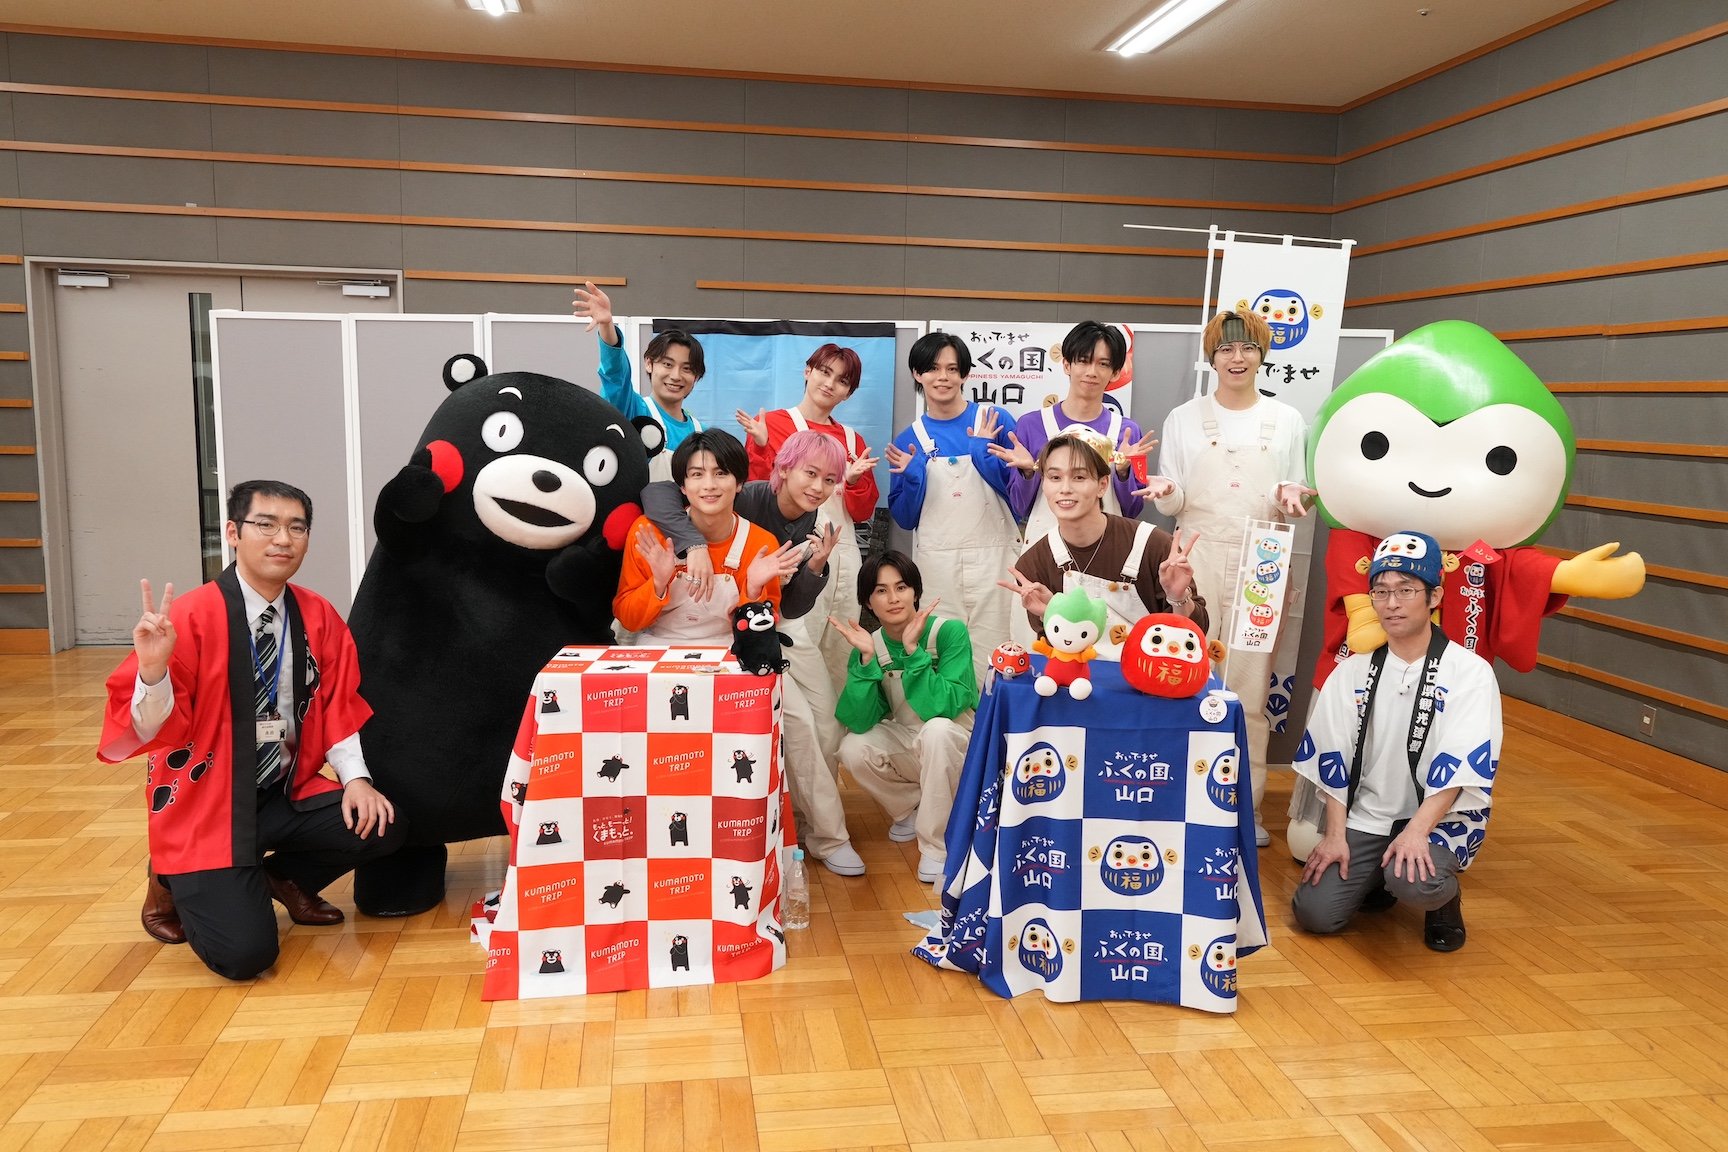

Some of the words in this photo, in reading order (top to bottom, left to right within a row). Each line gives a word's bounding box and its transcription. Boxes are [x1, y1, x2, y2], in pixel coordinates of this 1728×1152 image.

[970, 331, 1030, 345] おいでませ
[970, 346, 1053, 373] くの国、
[1256, 361, 1320, 384] でませ
[971, 381, 1026, 405] 山口
[1156, 661, 1182, 686] 福
[586, 686, 639, 701] KUMAMOTO
[718, 687, 770, 702] KUMAMOTO
[603, 697, 625, 708] TRIP
[734, 699, 756, 709] TRIP
[653, 750, 705, 765] KUMAMOTO
[1115, 751, 1158, 762] おいでませ
[538, 763, 561, 775] TRIP
[669, 762, 691, 772] TRIP
[1098, 760, 1174, 781] ふくの国、
[1028, 779, 1047, 797] 福
[1115, 785, 1154, 803] 山口
[717, 816, 765, 829] KUMAMOTO
[732, 828, 752, 837] TRIP
[1021, 836, 1055, 848] おいでませ
[1011, 847, 1071, 872] ふくの国、
[653, 873, 705, 889] KUMAMOTO
[1023, 869, 1053, 889] 山口
[1121, 872, 1143, 890] 福
[524, 877, 577, 898] KUMAMOTO
[669, 884, 691, 895] TRIP
[540, 891, 563, 904] TRIP
[1109, 929, 1152, 941] おいでませ
[590, 938, 640, 959] KUMAMOTO
[717, 937, 763, 952] KUMAMOTO
[1093, 940, 1169, 962] ふくの国、
[606, 951, 627, 964] TRIP
[1110, 964, 1149, 982] 山口
